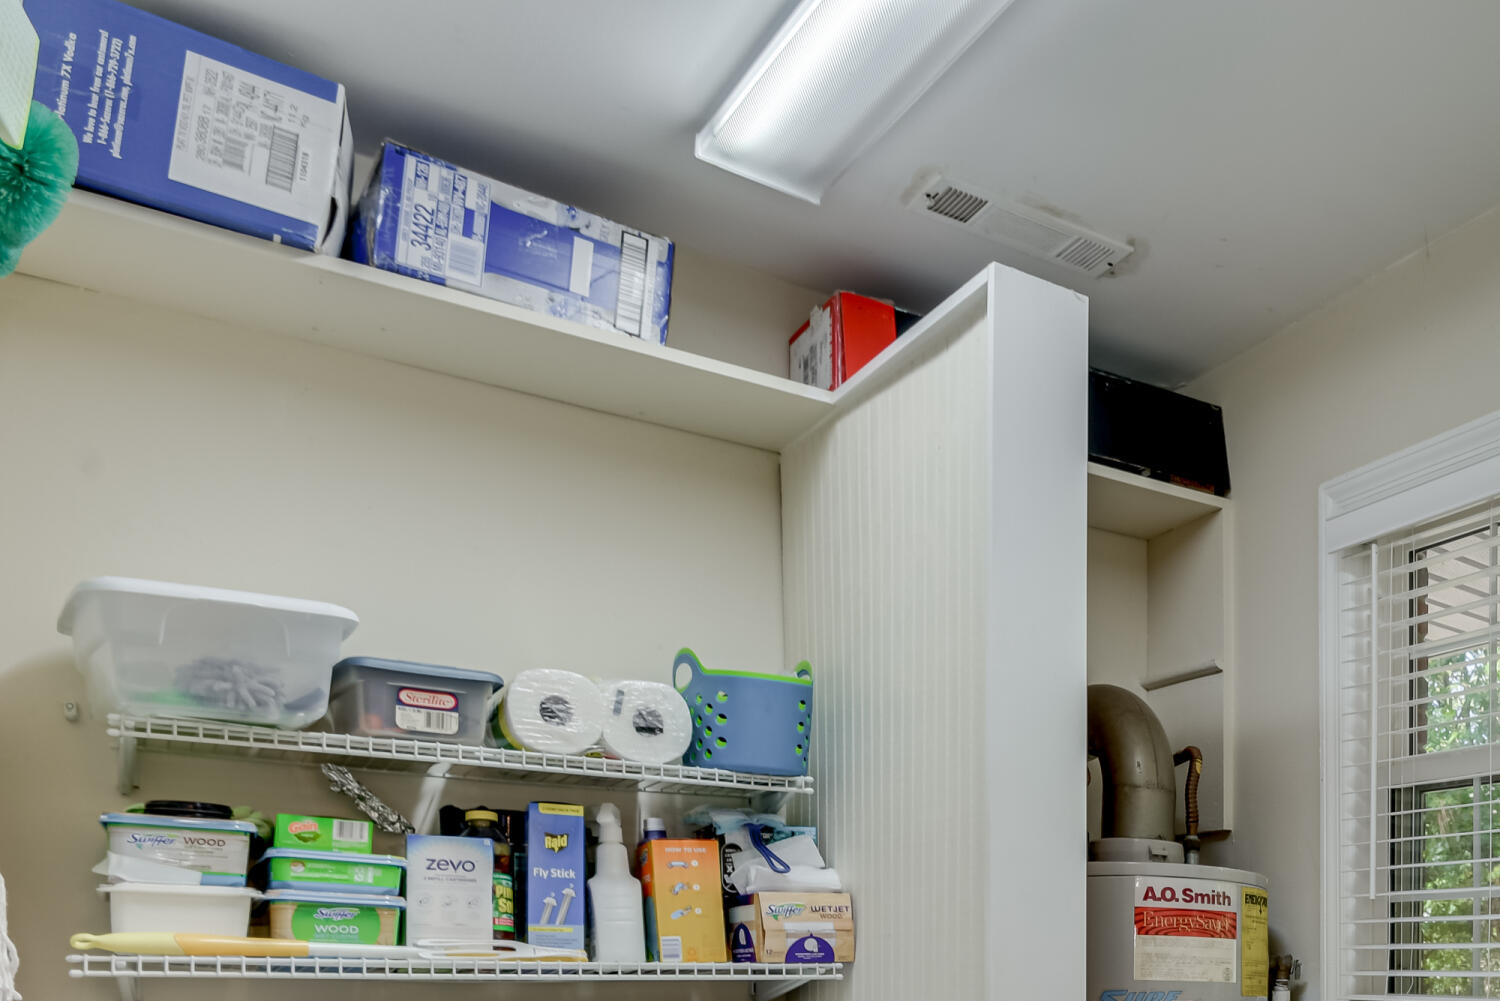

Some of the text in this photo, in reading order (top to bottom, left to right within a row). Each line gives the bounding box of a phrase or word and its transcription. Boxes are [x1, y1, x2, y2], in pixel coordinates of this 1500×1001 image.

[55, 80, 69, 119] latinum
[63, 32, 77, 62] Vodka
[411, 204, 435, 251] 34422
[288, 821, 319, 834] Gain
[127, 833, 226, 848] Swiffer WOOD
[544, 834, 569, 851] Raid
[426, 858, 476, 873] zevo
[533, 867, 576, 880] Fly Stick
[1143, 886, 1232, 907] A.O. Smith
[313, 907, 359, 921] Swiffer
[767, 904, 850, 919] Swiffer WETJET
[314, 924, 359, 935] WOOD
